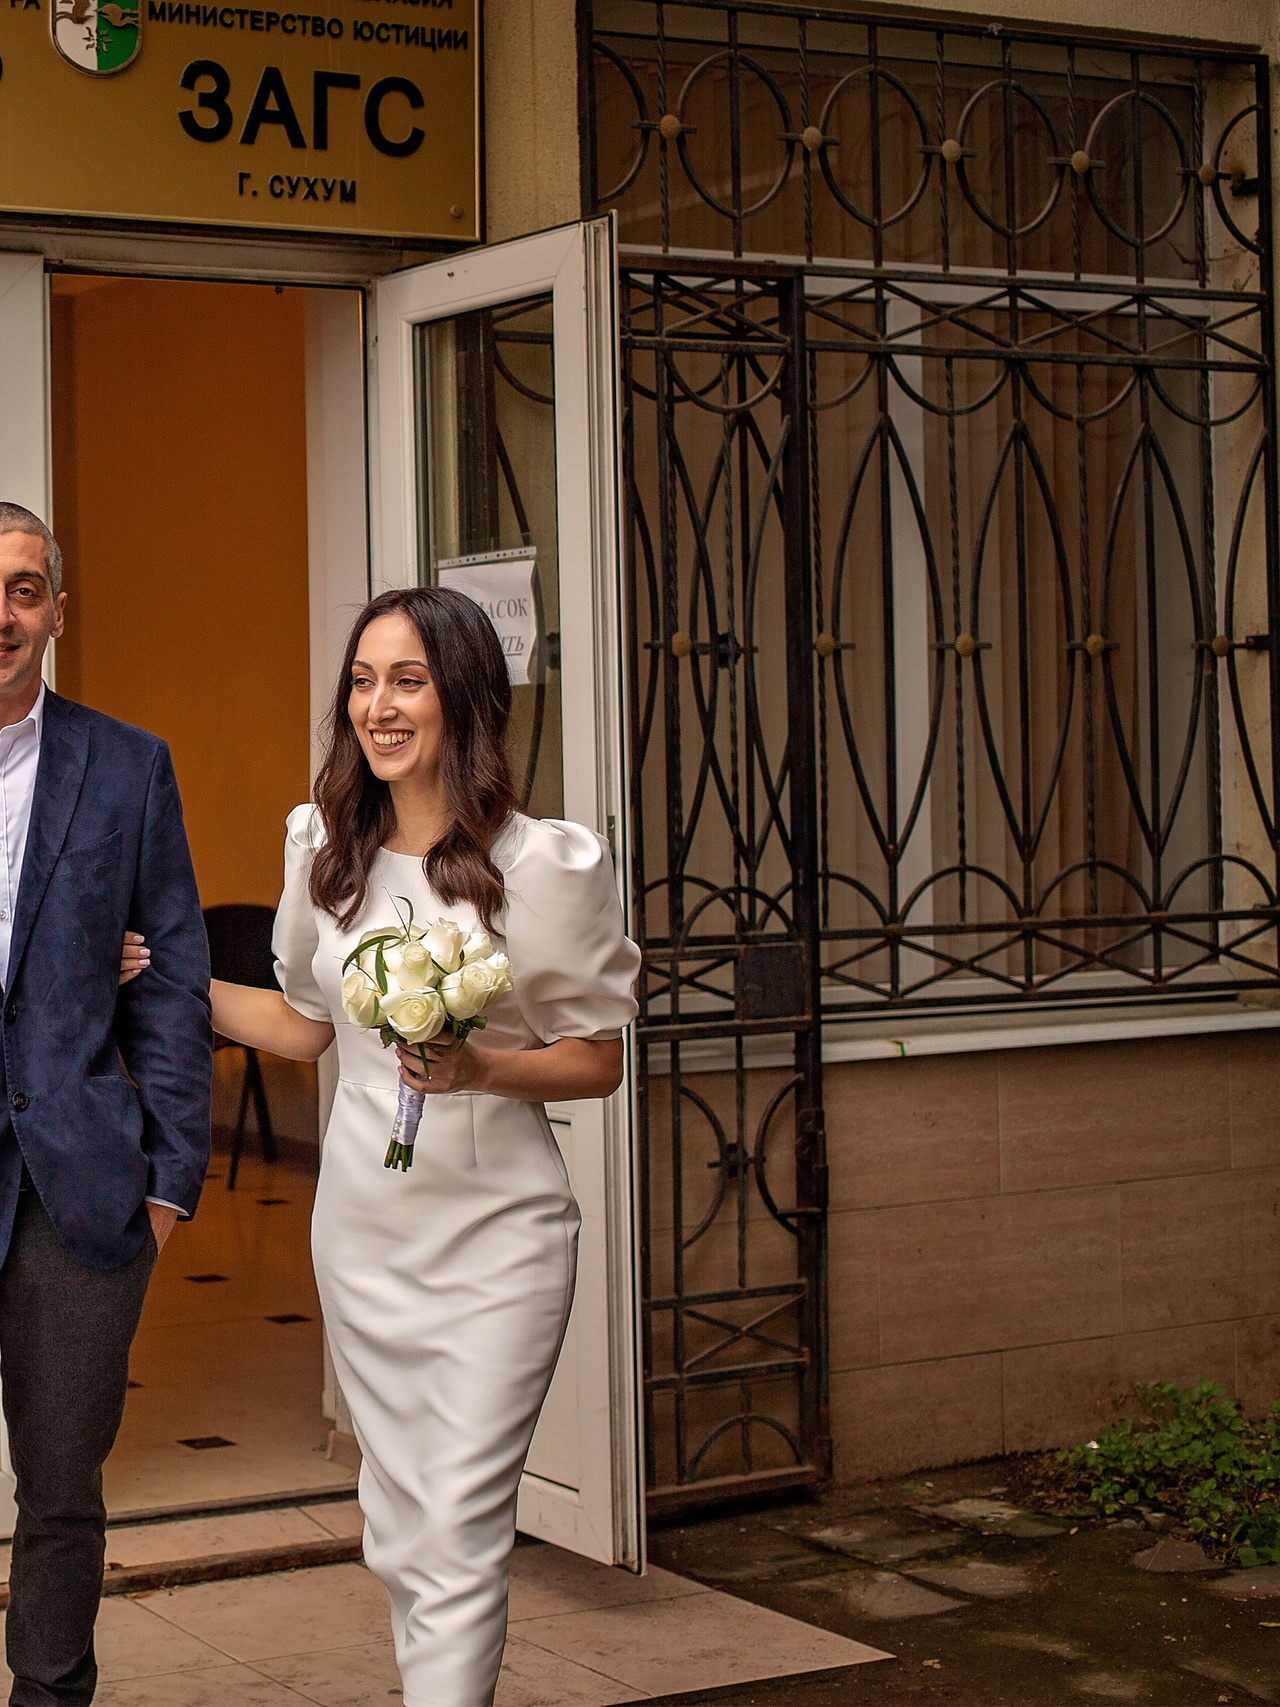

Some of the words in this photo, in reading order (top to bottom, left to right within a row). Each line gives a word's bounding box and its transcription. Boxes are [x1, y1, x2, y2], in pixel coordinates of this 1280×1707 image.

[148, 1, 344, 39] МИНИСТЕРСТВО
[352, 19, 469, 51] ЮСТИЦИИ
[177, 59, 426, 158] ЗАГС
[269, 174, 357, 203] СУХУМ
[480, 597, 528, 619] АСОК
